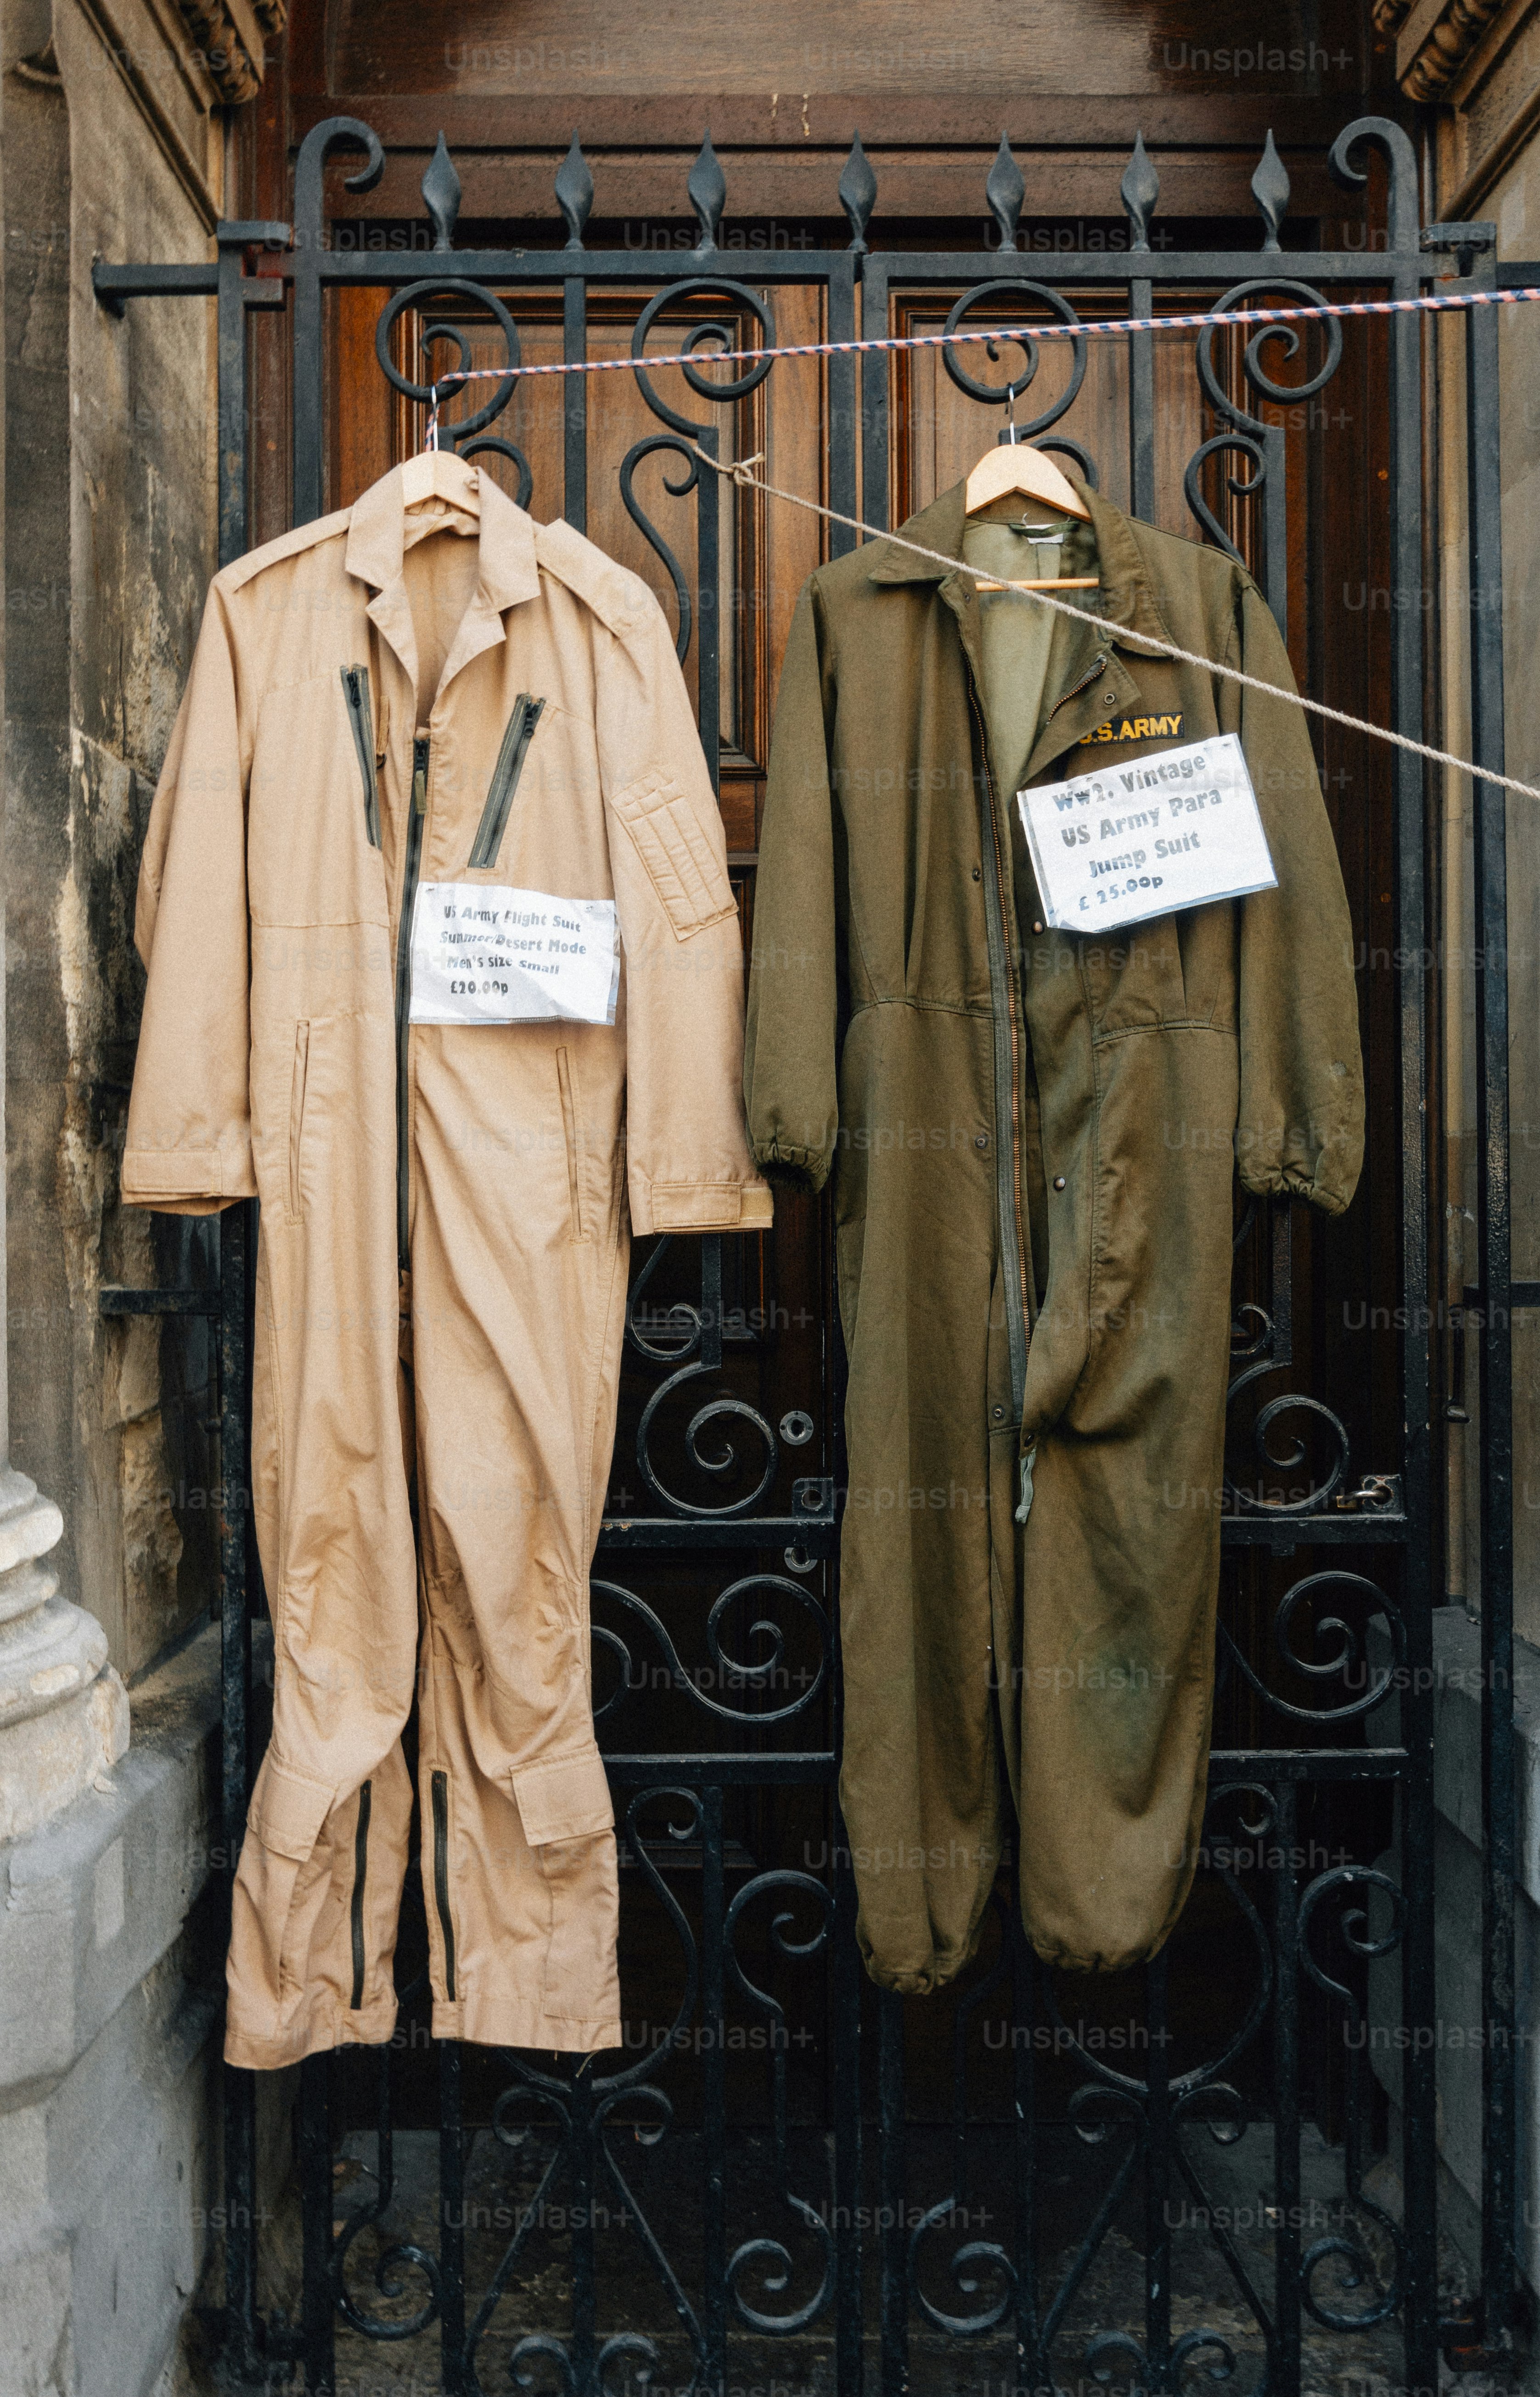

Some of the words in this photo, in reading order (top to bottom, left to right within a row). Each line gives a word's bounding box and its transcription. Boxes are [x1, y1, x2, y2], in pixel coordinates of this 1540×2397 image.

[1119, 756, 1206, 793] Vintage
[1061, 824, 1090, 847] US
[1100, 807, 1160, 840] Army
[1169, 789, 1222, 817] Para
[1089, 849, 1146, 878] Jump
[1154, 830, 1201, 859] Suit
[444, 905, 456, 919] US
[461, 907, 500, 925] Army
[504, 910, 547, 927] Flight
[552, 915, 581, 932] Suit
[548, 939, 586, 954] Mode
[447, 956, 483, 969] Men's
[488, 954, 513, 967] size
[450, 980, 509, 996] £20.00p
